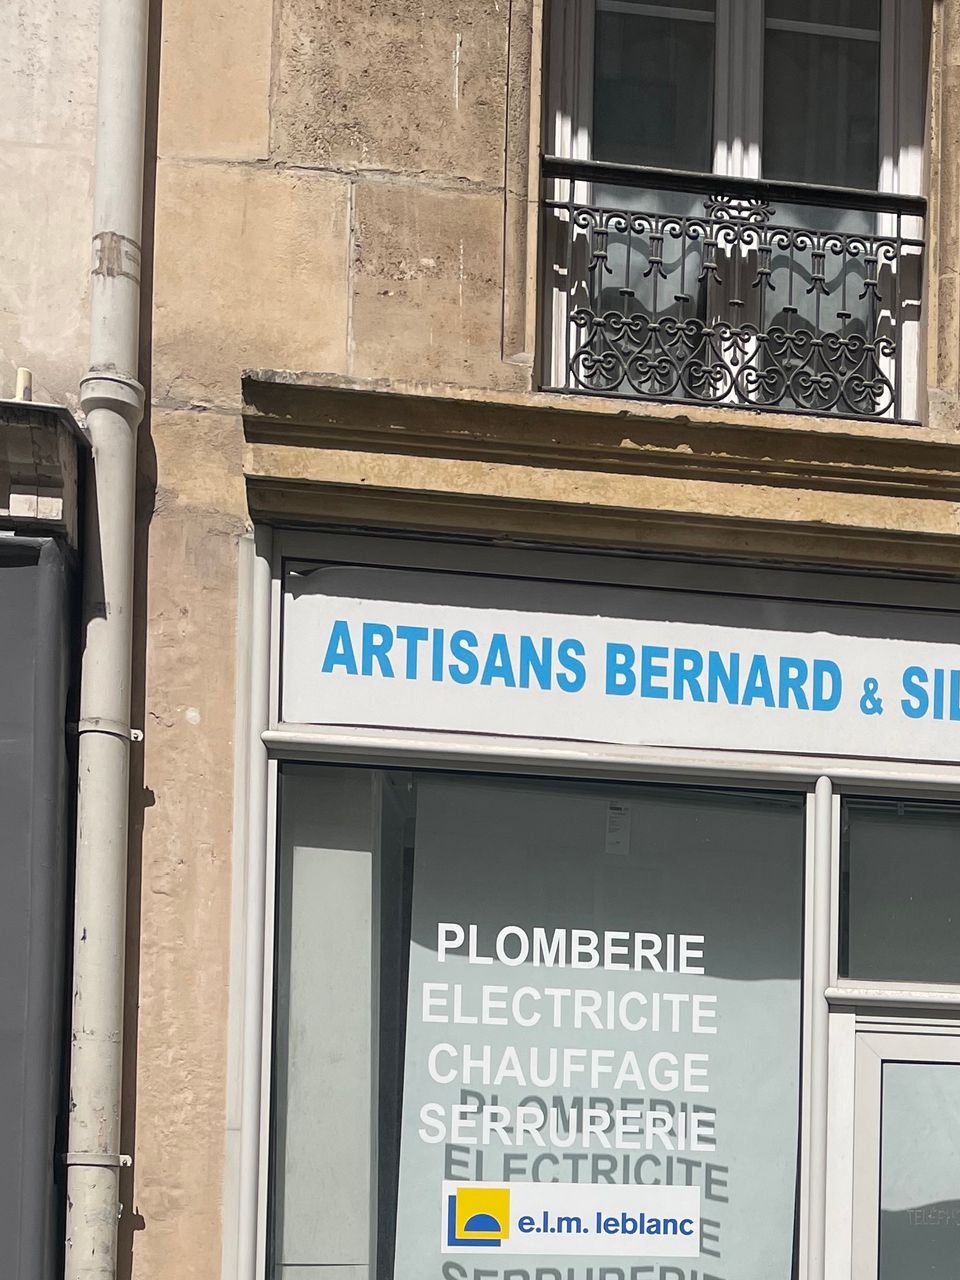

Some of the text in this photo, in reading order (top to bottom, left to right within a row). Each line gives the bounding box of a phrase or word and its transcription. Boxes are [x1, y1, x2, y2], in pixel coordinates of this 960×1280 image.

[322, 620, 587, 693] ARTISANS
[606, 643, 842, 712] BERNARD
[860, 678, 884, 715] &
[437, 922, 706, 975] PLOMBERIE
[422, 982, 718, 1034] ELECTRICITE
[428, 1043, 710, 1093] CHAUFFAGE
[418, 1102, 716, 1152] SERRURERIE
[518, 1211, 694, 1236] e.l.m. leblanc
